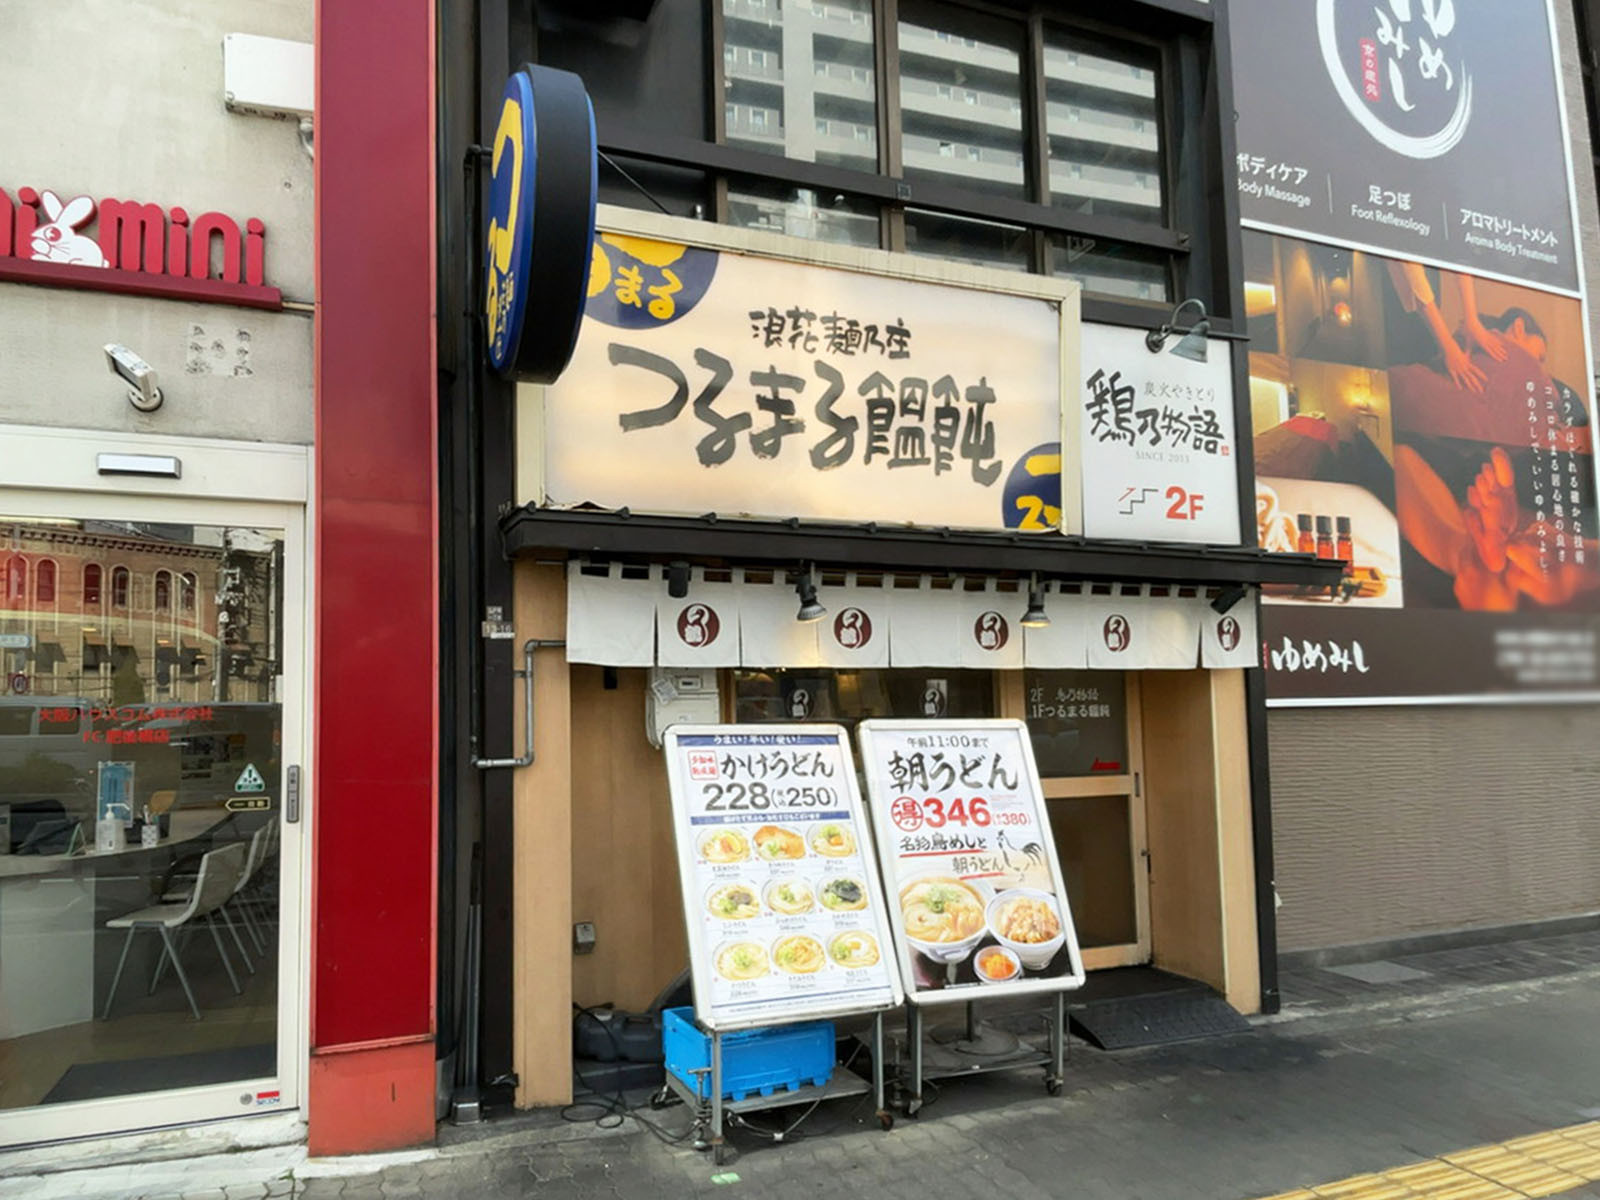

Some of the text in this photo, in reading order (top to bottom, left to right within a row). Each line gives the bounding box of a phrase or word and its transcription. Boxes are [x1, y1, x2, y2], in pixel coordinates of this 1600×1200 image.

[1236, 152, 1308, 184] ボディケア
[1264, 184, 1311, 208] Massage
[1351, 205, 1430, 236] Foot Reflexology
[1460, 208, 1558, 247] アロマトリートメント
[99, 198, 265, 287] mini
[1465, 232, 1558, 264] Aroma Body Treatment
[1144, 382, 1215, 402] 炭火やきとり
[608, 343, 1002, 487] つるまる饂飩
[1136, 450, 1164, 462] SINCE
[1165, 485, 1205, 520] 2F
[1271, 636, 1370, 673] ゆめみし
[907, 735, 989, 748] 午前11:00まで
[720, 751, 834, 780] かけうどん
[888, 750, 1019, 794] 朝うどん
[702, 782, 771, 811] 228
[923, 797, 991, 828] 346
[952, 857, 1005, 874] 朝うどん
